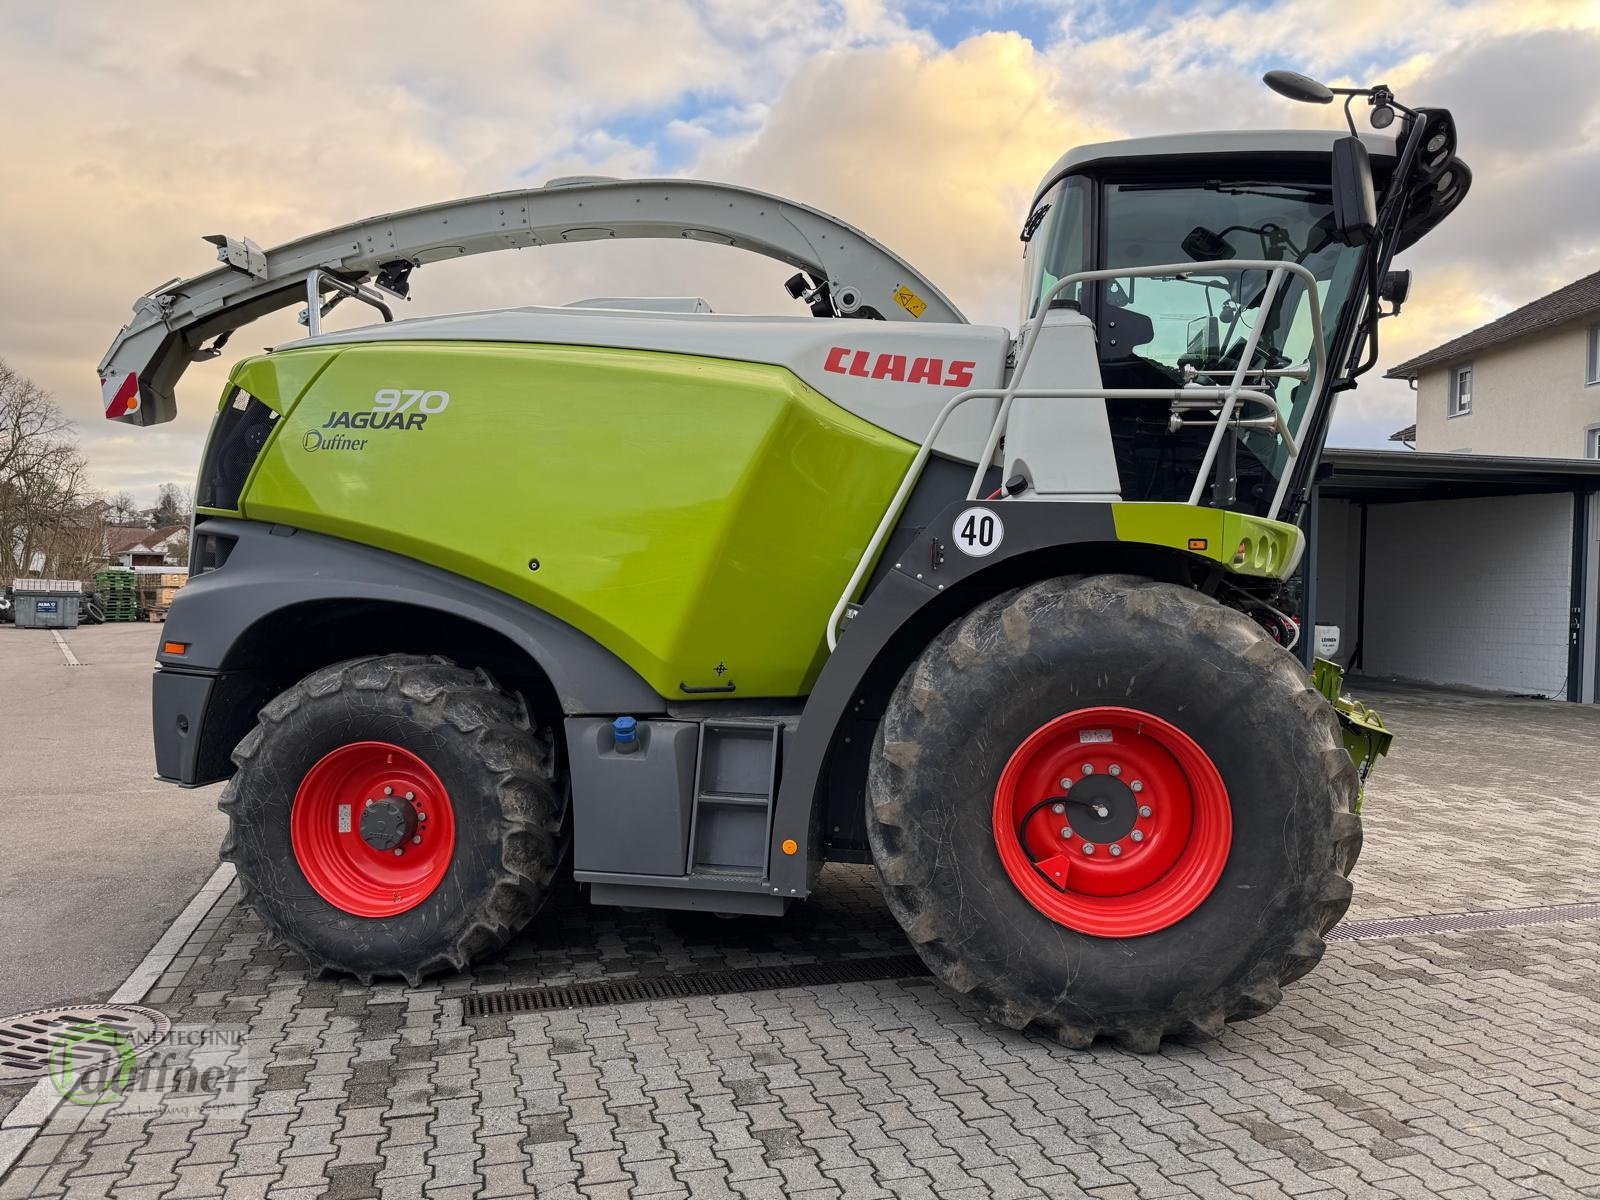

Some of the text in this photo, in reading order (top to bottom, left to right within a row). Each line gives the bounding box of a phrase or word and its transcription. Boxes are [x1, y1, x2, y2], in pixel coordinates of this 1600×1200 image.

[824, 346, 976, 387] CLAAS
[372, 389, 450, 413] 970
[322, 411, 428, 430] JAGUAR
[303, 429, 368, 452] Duffner
[961, 515, 994, 546] 40
